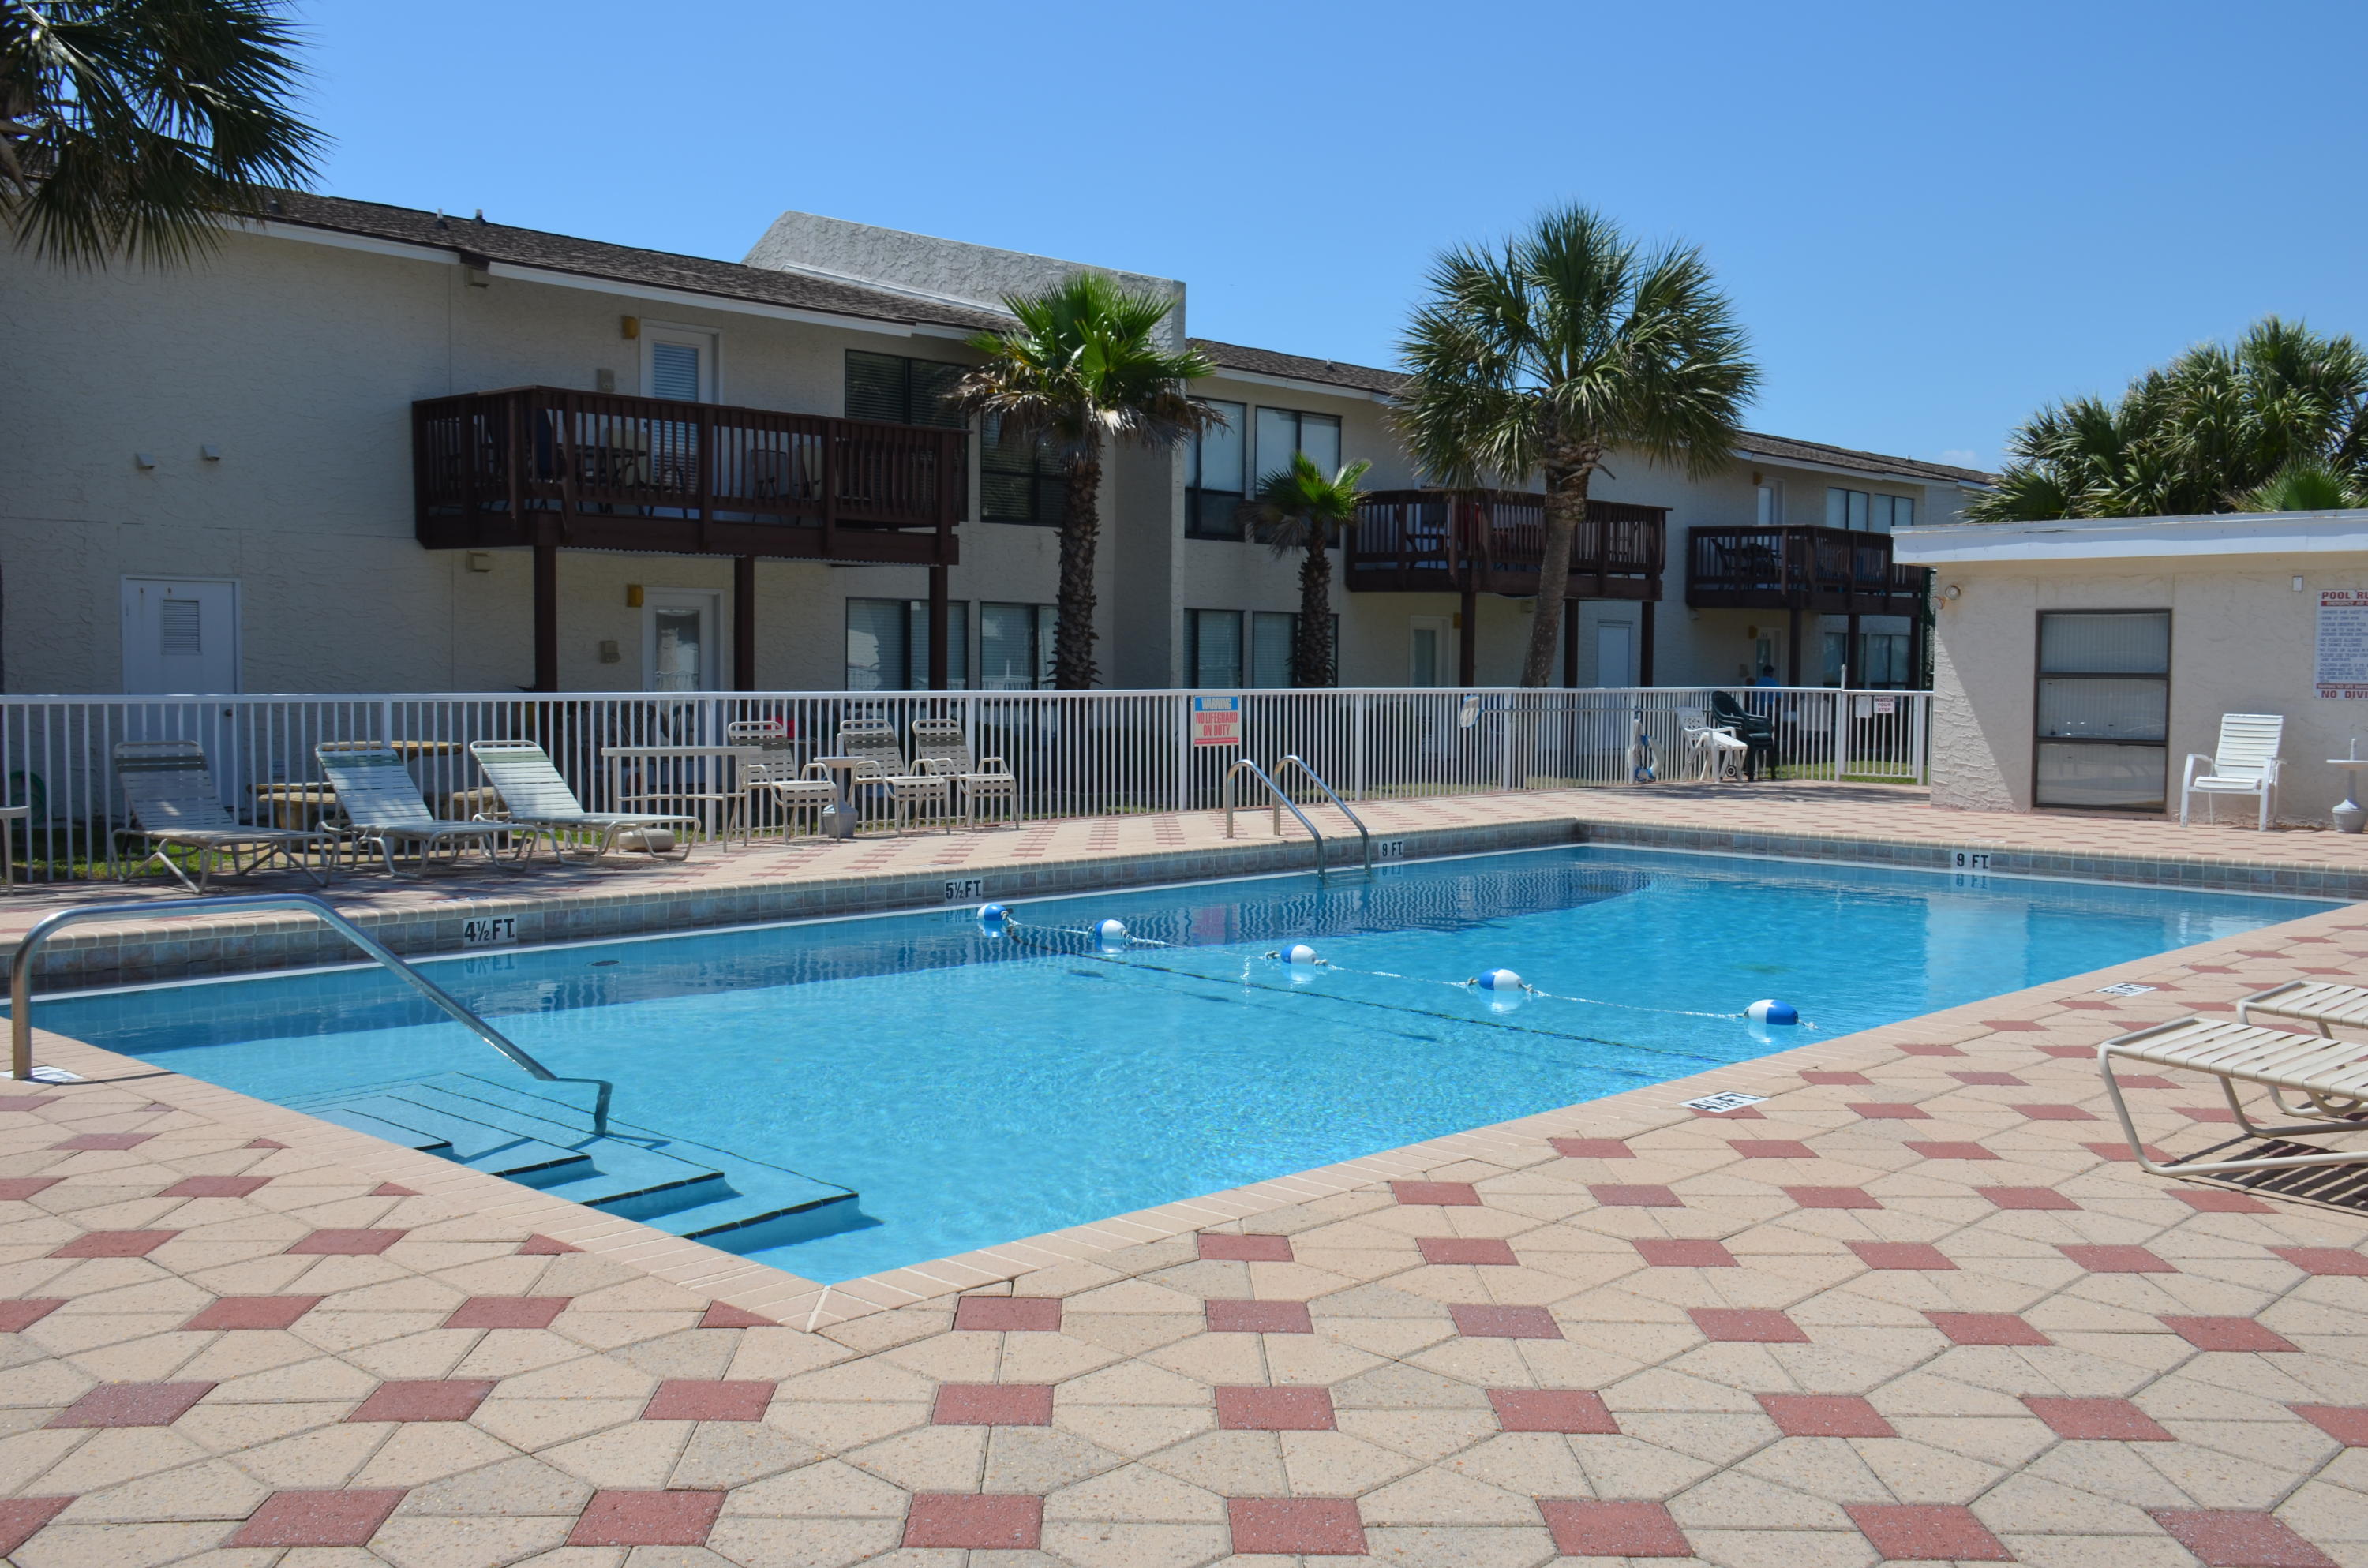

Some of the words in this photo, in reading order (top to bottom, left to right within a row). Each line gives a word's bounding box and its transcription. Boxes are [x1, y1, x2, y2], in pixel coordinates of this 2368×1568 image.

[2322, 591, 2351, 600] POOL
[1201, 697, 1231, 710] WARNING
[1196, 712, 1205, 724] NO
[1205, 711, 1238, 724] LIFEGUARD
[1203, 724, 1212, 736] ON
[1214, 724, 1231, 736] DUTY
[1382, 843, 1388, 857] 9
[1957, 853, 1965, 867] 9
